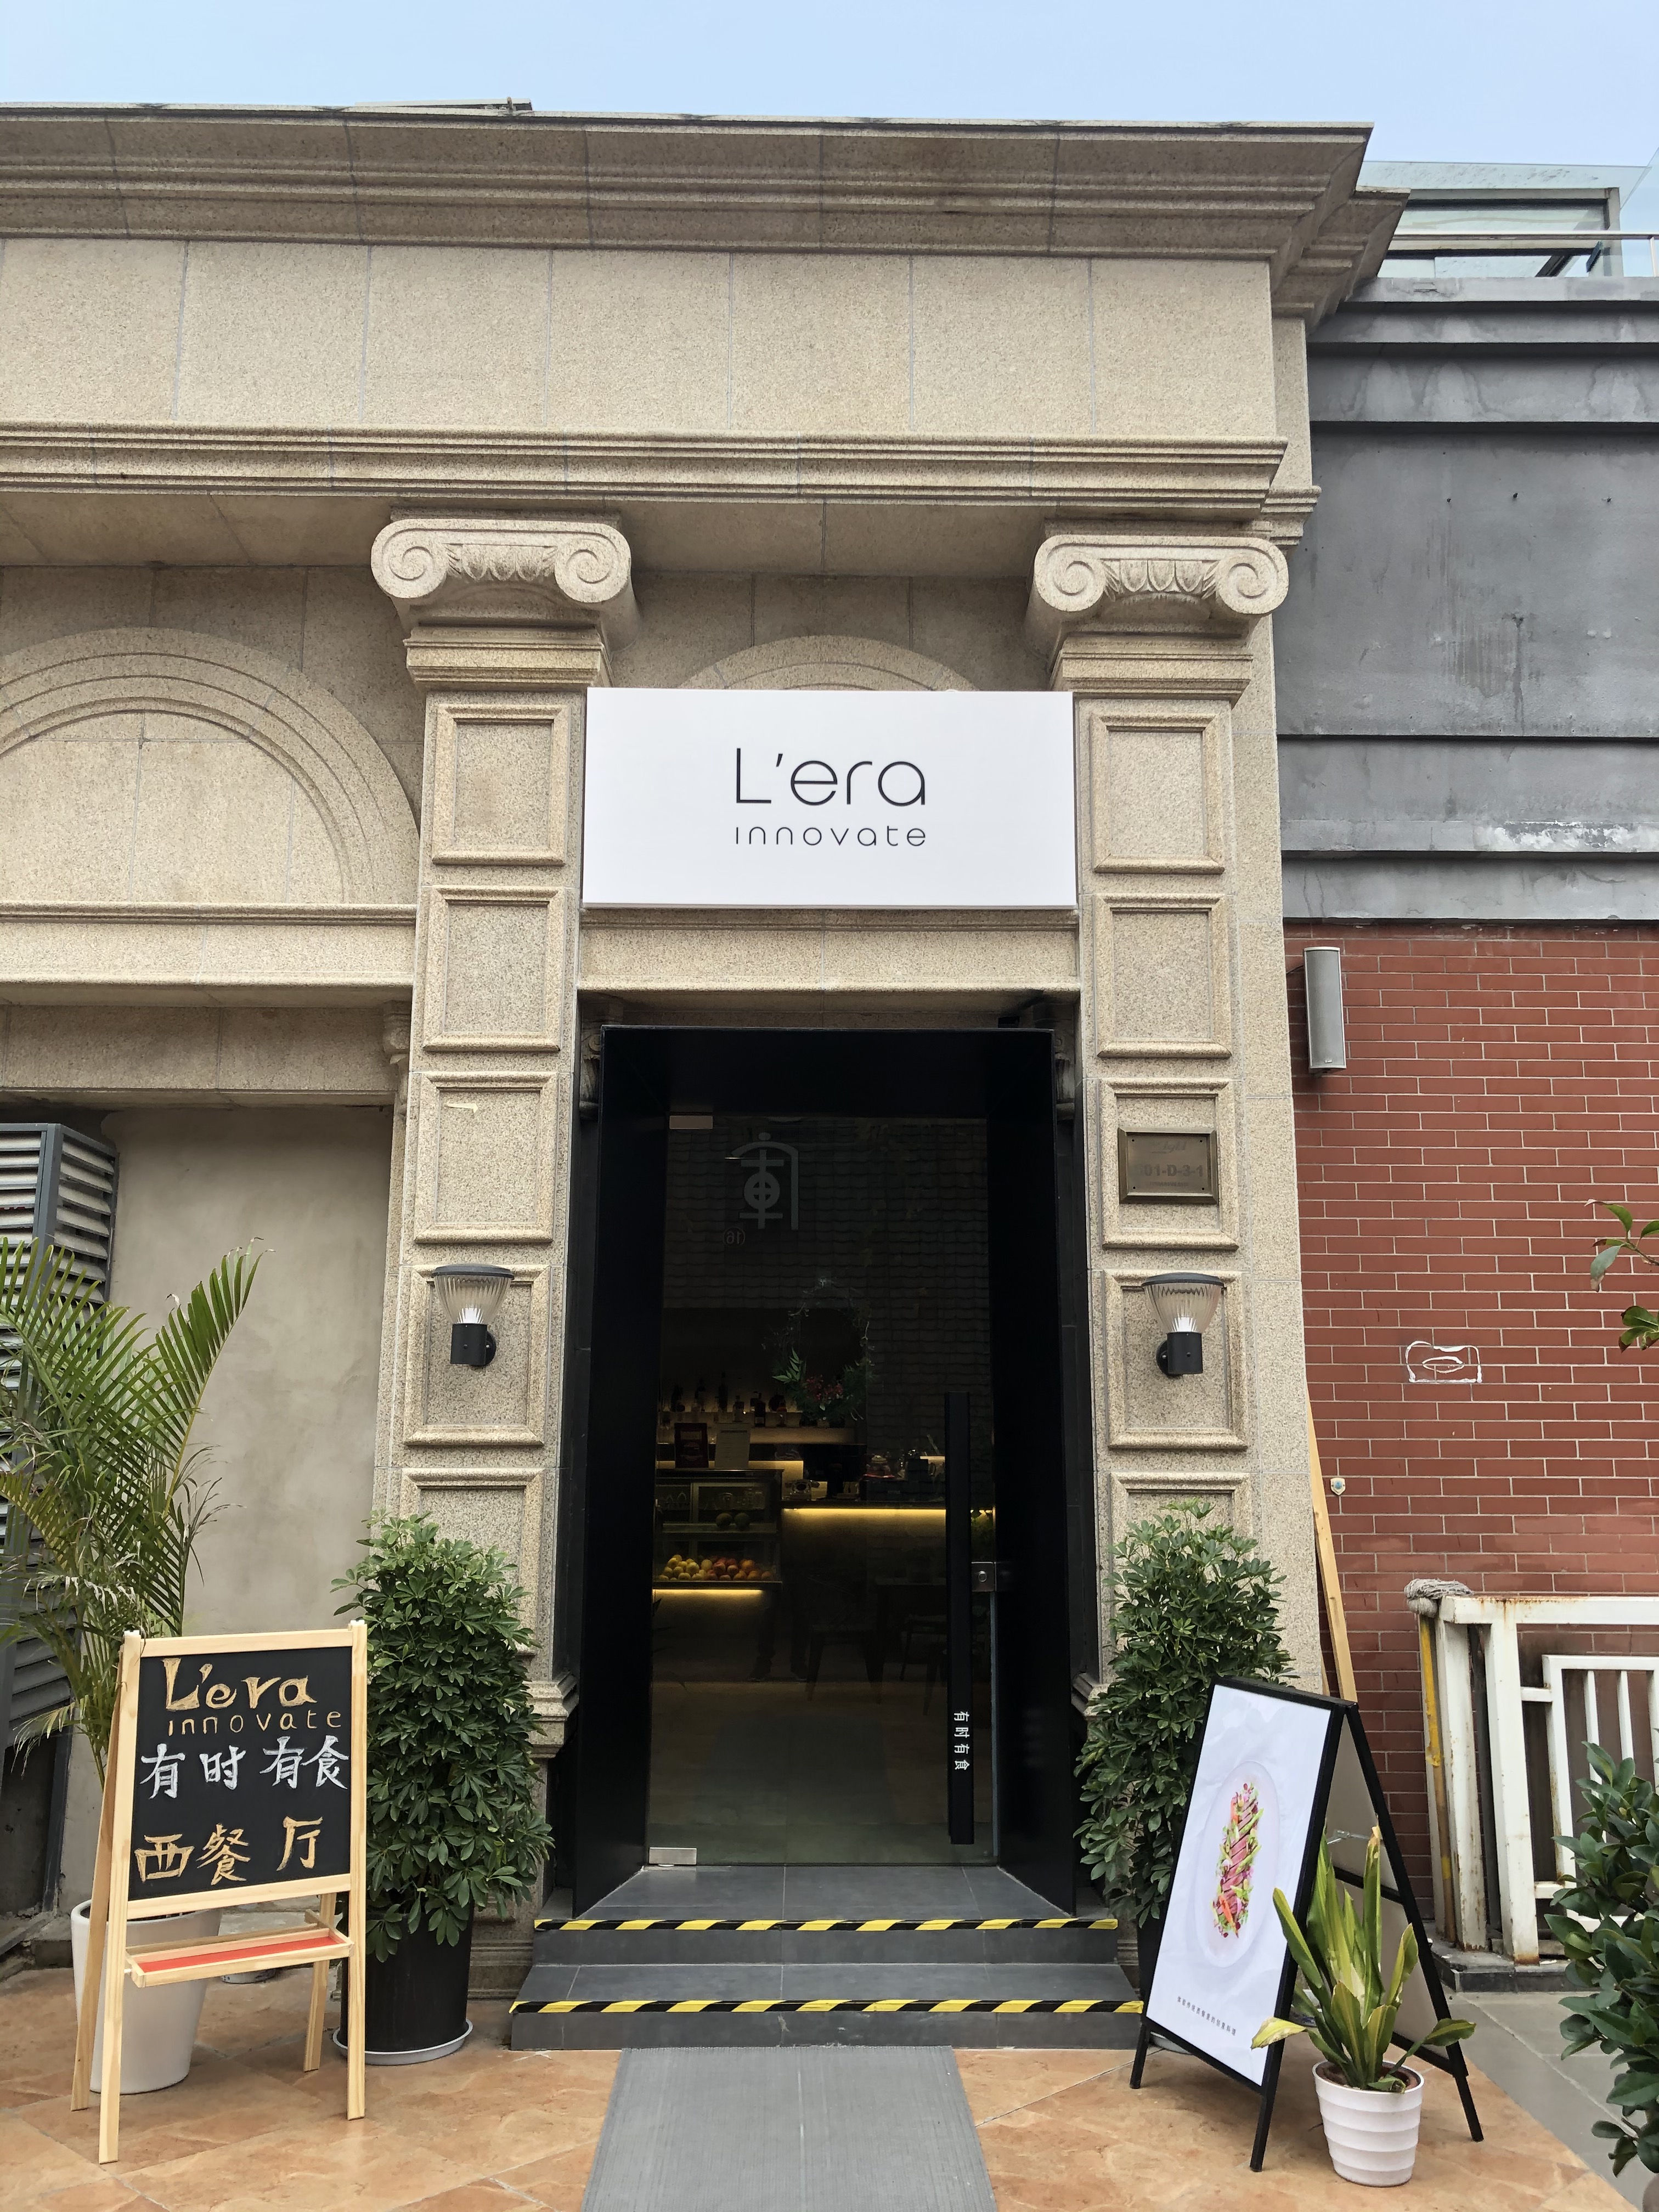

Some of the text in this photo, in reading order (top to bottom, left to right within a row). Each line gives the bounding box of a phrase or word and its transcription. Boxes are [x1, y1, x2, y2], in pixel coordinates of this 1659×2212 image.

[736, 747, 926, 807] L'era
[736, 825, 926, 847] innovate
[162, 1657, 317, 1711] L'era
[168, 1710, 342, 1736] innovate
[953, 1711, 970, 1770] 有时有食
[139, 1735, 349, 1799] 有时有食
